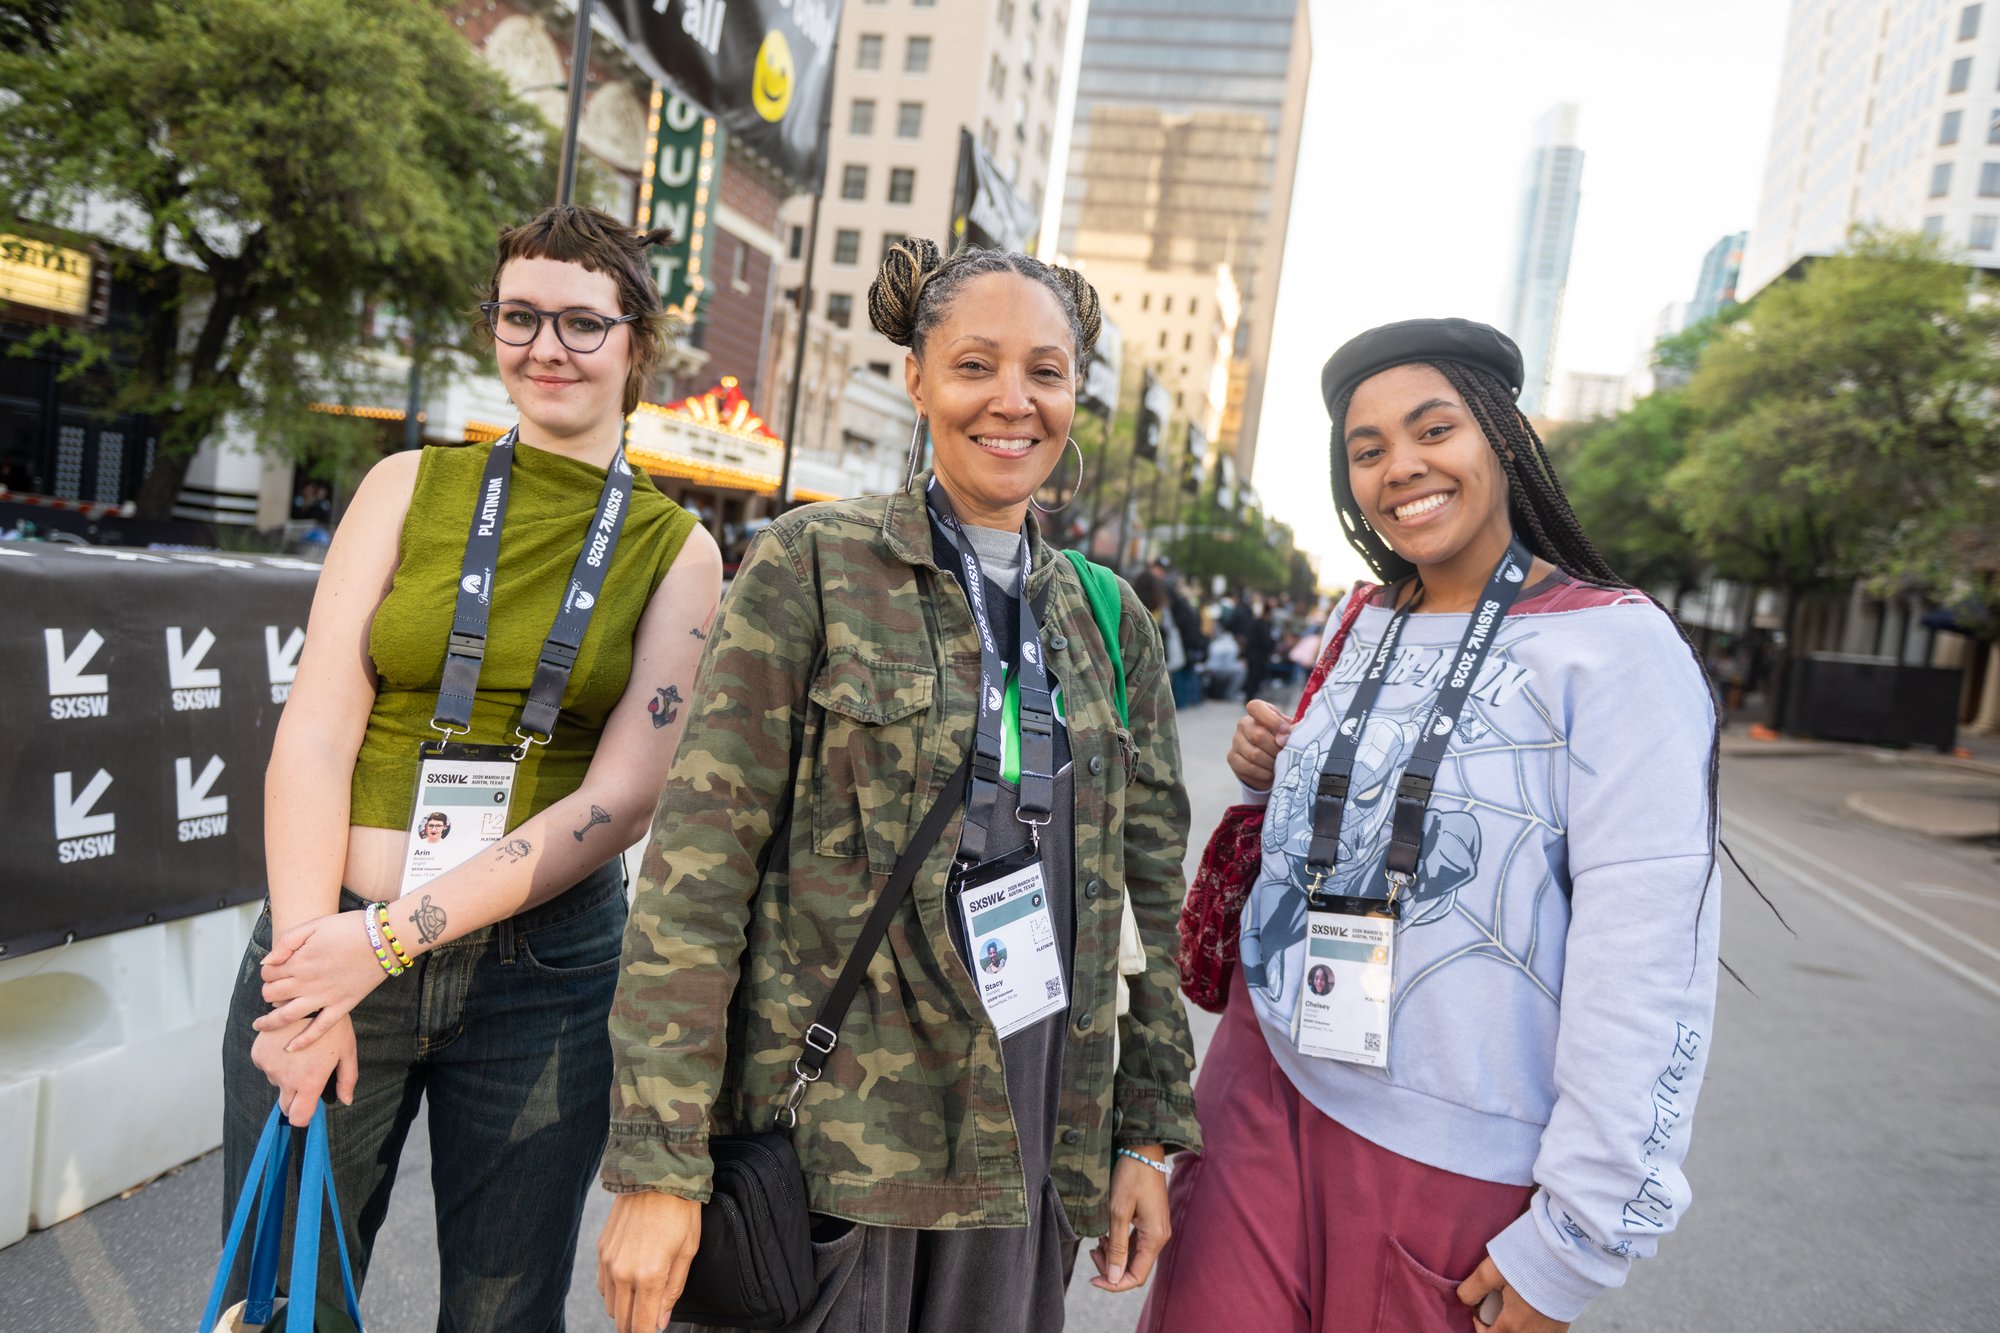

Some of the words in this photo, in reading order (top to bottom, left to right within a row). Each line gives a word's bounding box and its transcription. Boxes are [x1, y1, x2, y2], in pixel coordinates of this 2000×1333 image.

[477, 477, 504, 537] PLATINUM
[601, 487, 624, 524] SXSW
[586, 532, 609, 568] 2026
[964, 553, 981, 600] SXSW
[977, 611, 994, 654] 2026
[1474, 600, 1500, 638] SXSW
[1368, 615, 1403, 680] PLATINUM
[1450, 652, 1477, 689] 2026
[50, 694, 109, 720] SXSW
[172, 688, 221, 711] SXSW
[271, 684, 292, 704] SX
[426, 773, 459, 784] SXSW
[178, 814, 228, 843] SXSW
[58, 833, 116, 864] SXSW
[969, 892, 997, 913] SXSW
[1311, 924, 1339, 936] SXSW
[984, 979, 1004, 991] Stacy
[1305, 1000, 1331, 1011] Chelsey
